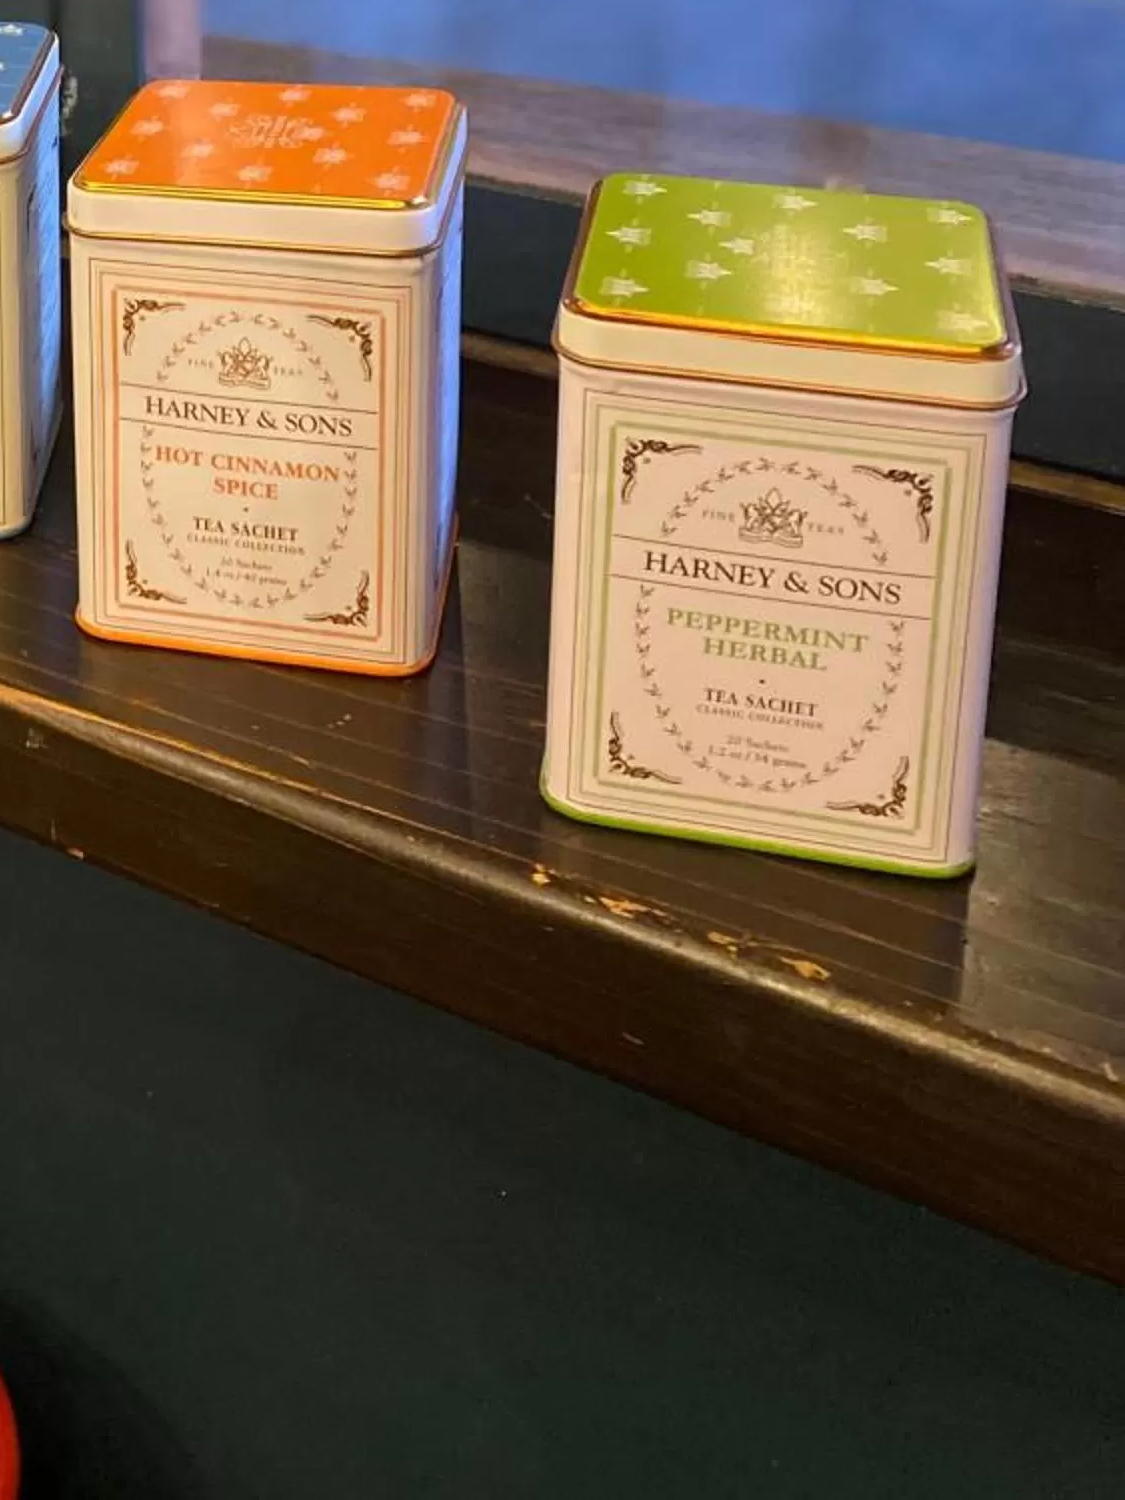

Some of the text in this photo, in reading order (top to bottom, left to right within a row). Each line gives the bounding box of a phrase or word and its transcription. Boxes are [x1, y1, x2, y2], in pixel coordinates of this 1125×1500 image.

[144, 395, 353, 438] HARNEY & SONS
[155, 445, 341, 483] HOT CINNAMON
[212, 476, 280, 500] SPICE
[193, 515, 300, 543] TEA SACHET
[642, 549, 903, 606] HARNEY & SONS
[666, 606, 870, 654] PEPPERMINT
[701, 635, 828, 672] HERBAL
[703, 687, 820, 718] TEA SACHET
